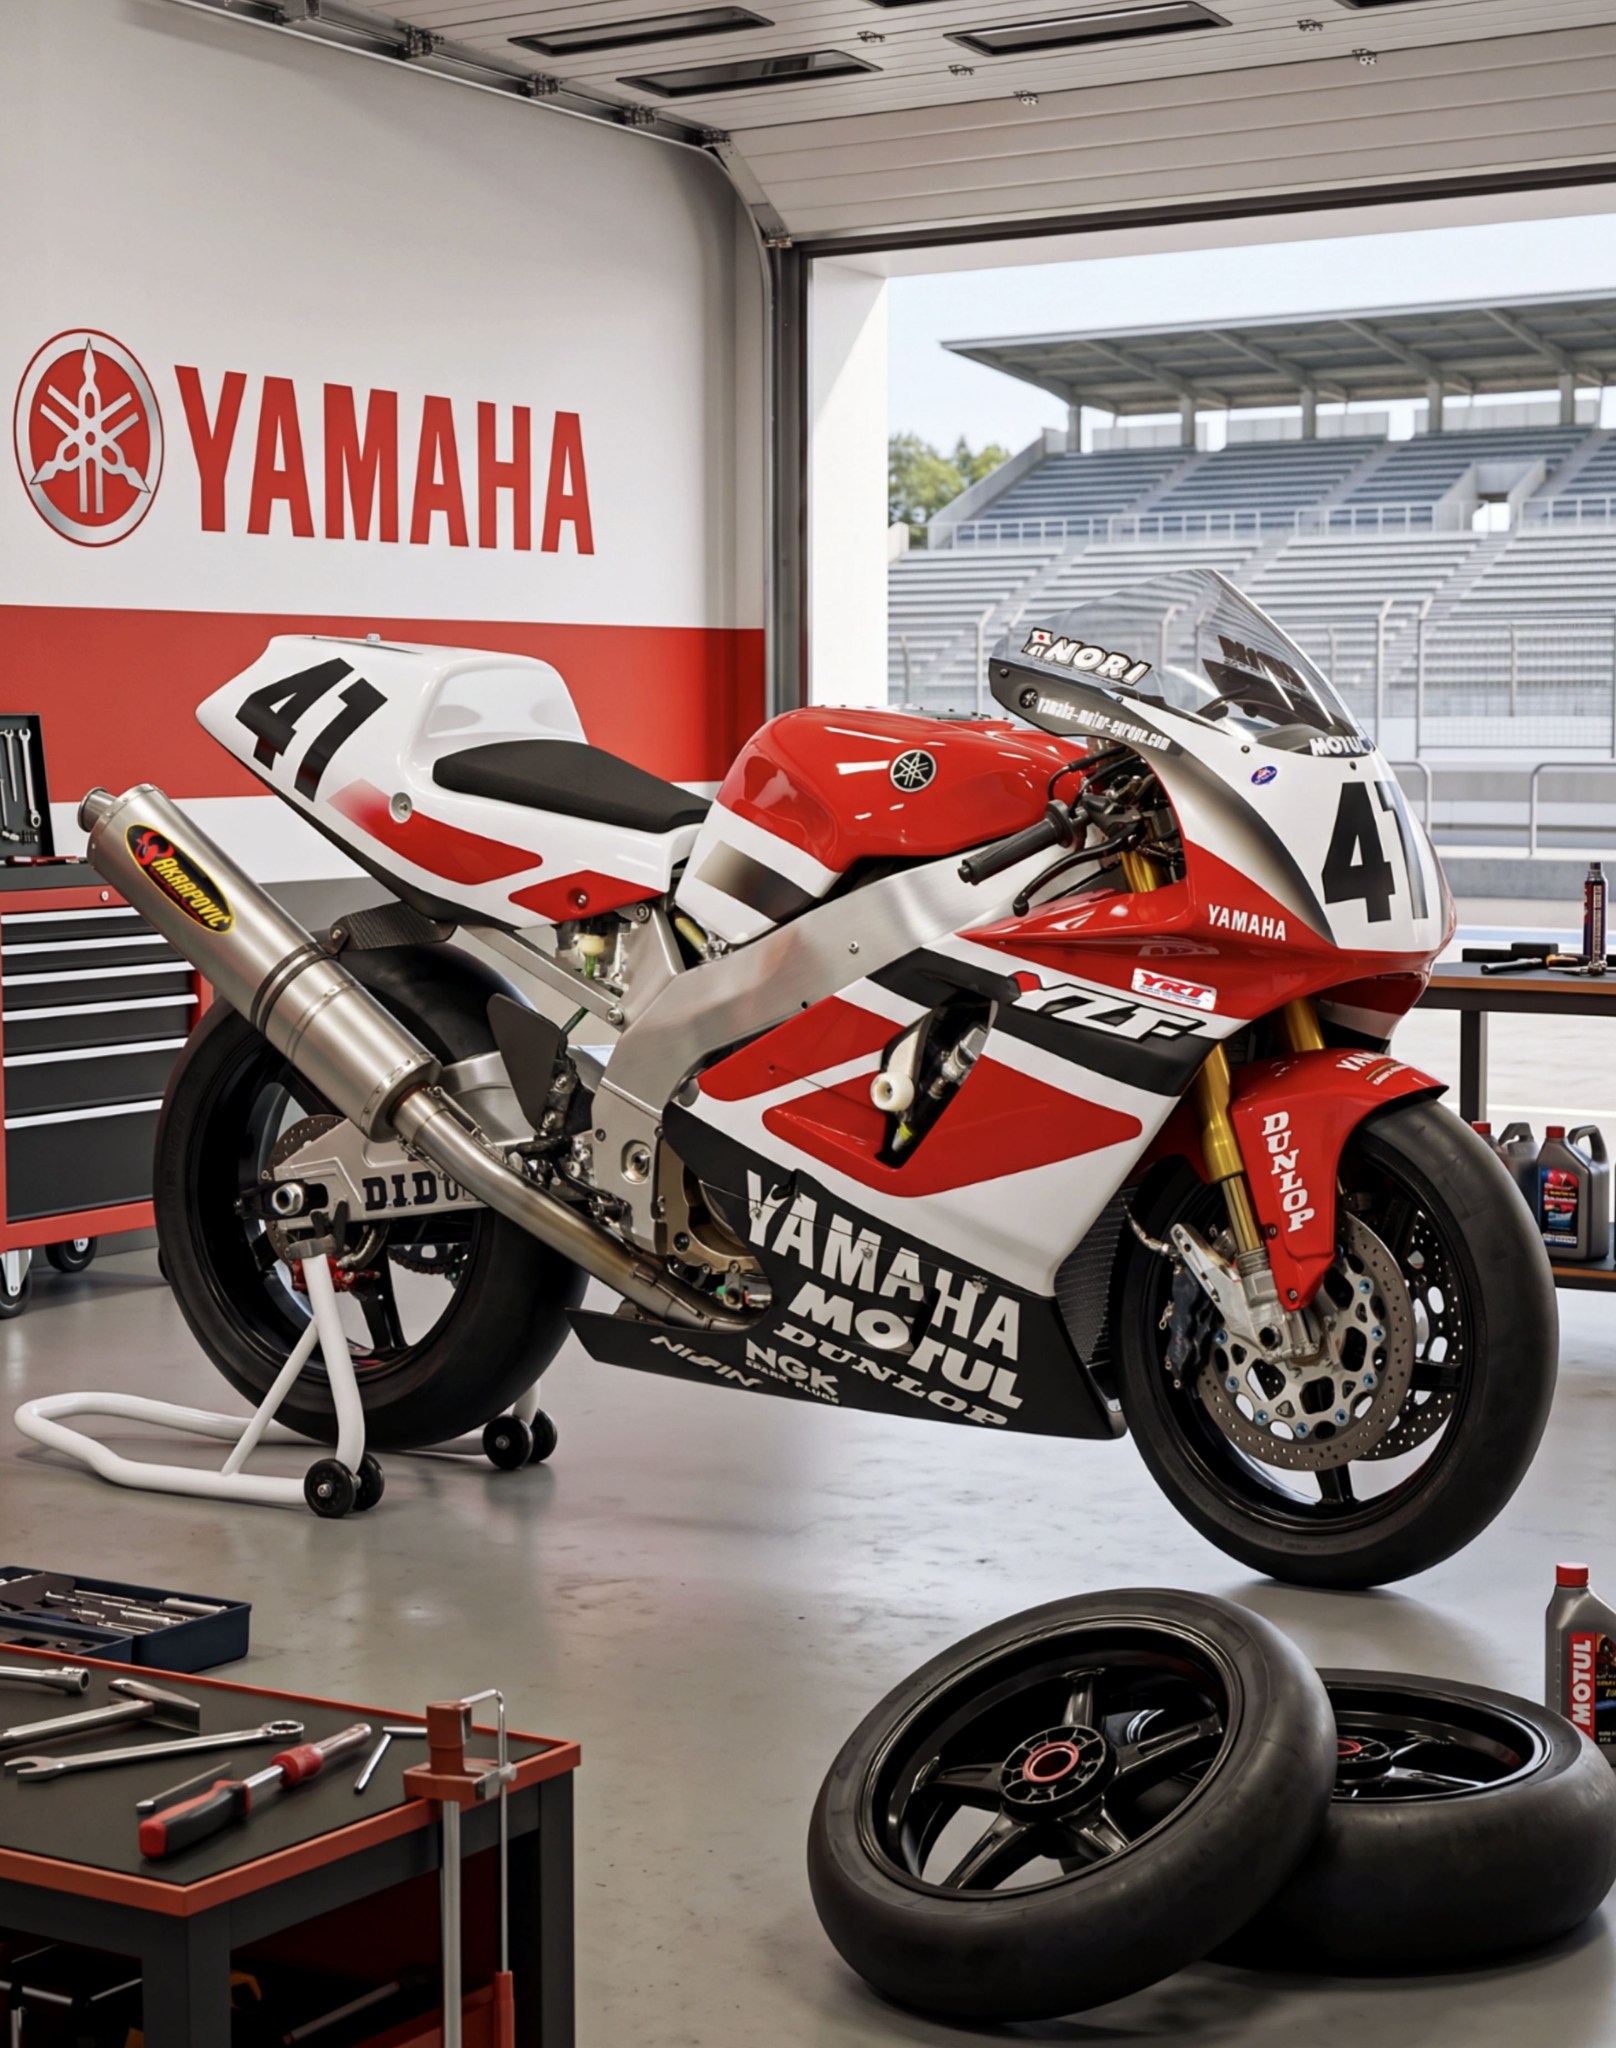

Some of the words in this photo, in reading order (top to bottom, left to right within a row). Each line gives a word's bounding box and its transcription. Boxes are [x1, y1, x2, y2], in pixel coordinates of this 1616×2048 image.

[174, 364, 595, 555] YAMAHA
[1043, 637, 1151, 686] NORI
[235, 657, 388, 802] 41
[1321, 781, 1429, 923] 41
[1208, 904, 1287, 941] YAMAHA
[1010, 971, 1206, 1041] YZF
[1141, 971, 1213, 999] YRT
[1261, 1111, 1315, 1232] DUNLOP
[747, 1169, 1020, 1361] YAMAHA
[745, 1359, 789, 1384] SPARK
[746, 1338, 839, 1397] NGK
[773, 1322, 1008, 1425] DUNLOP
[788, 1281, 1024, 1409] MOTUL
[1572, 1639, 1592, 1726] MOTUL
